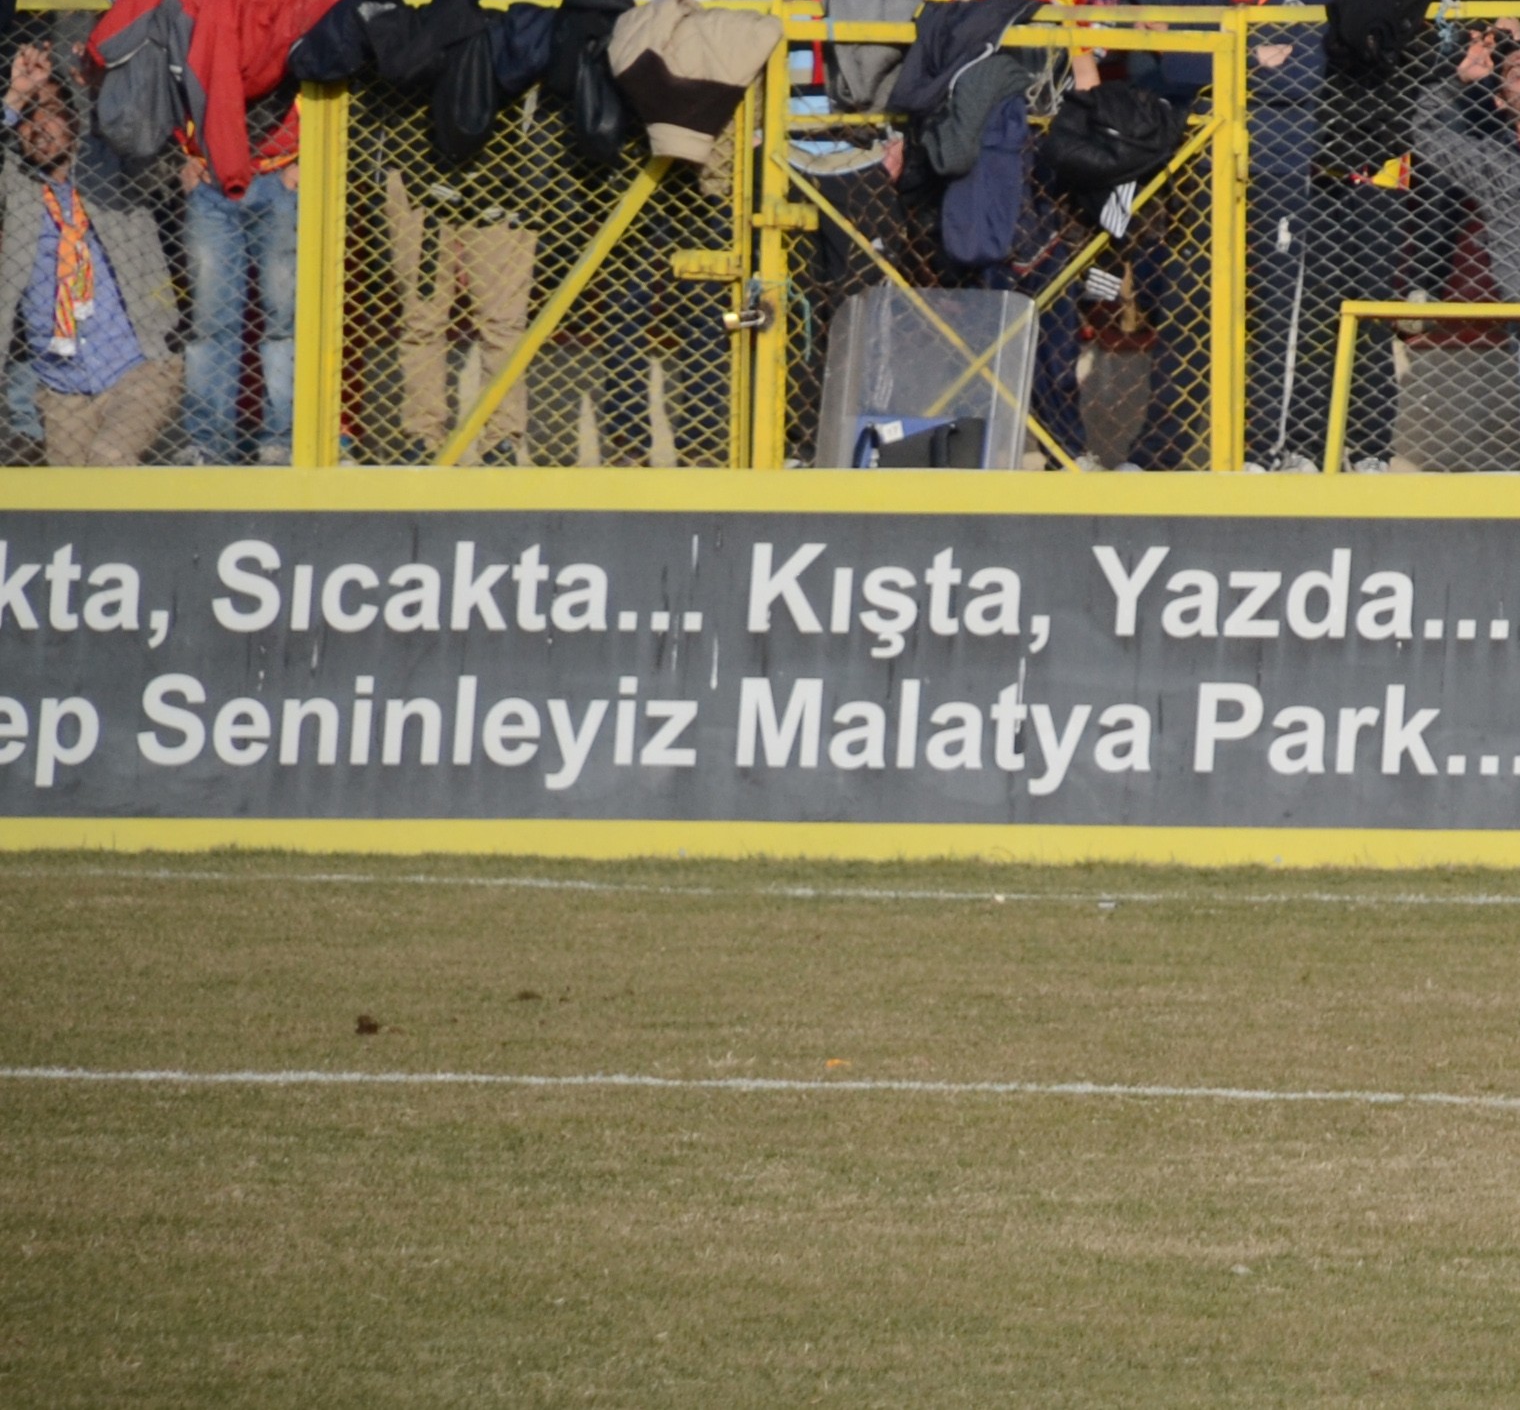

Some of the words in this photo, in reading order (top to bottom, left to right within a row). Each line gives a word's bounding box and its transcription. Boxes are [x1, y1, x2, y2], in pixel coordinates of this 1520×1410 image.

[212, 539, 703, 632] Sıcakta...
[747, 542, 1051, 659] Kışta,
[1092, 545, 1510, 640] Yazda...
[137, 673, 698, 791] Seninleyiz
[735, 677, 1152, 796] Malatya
